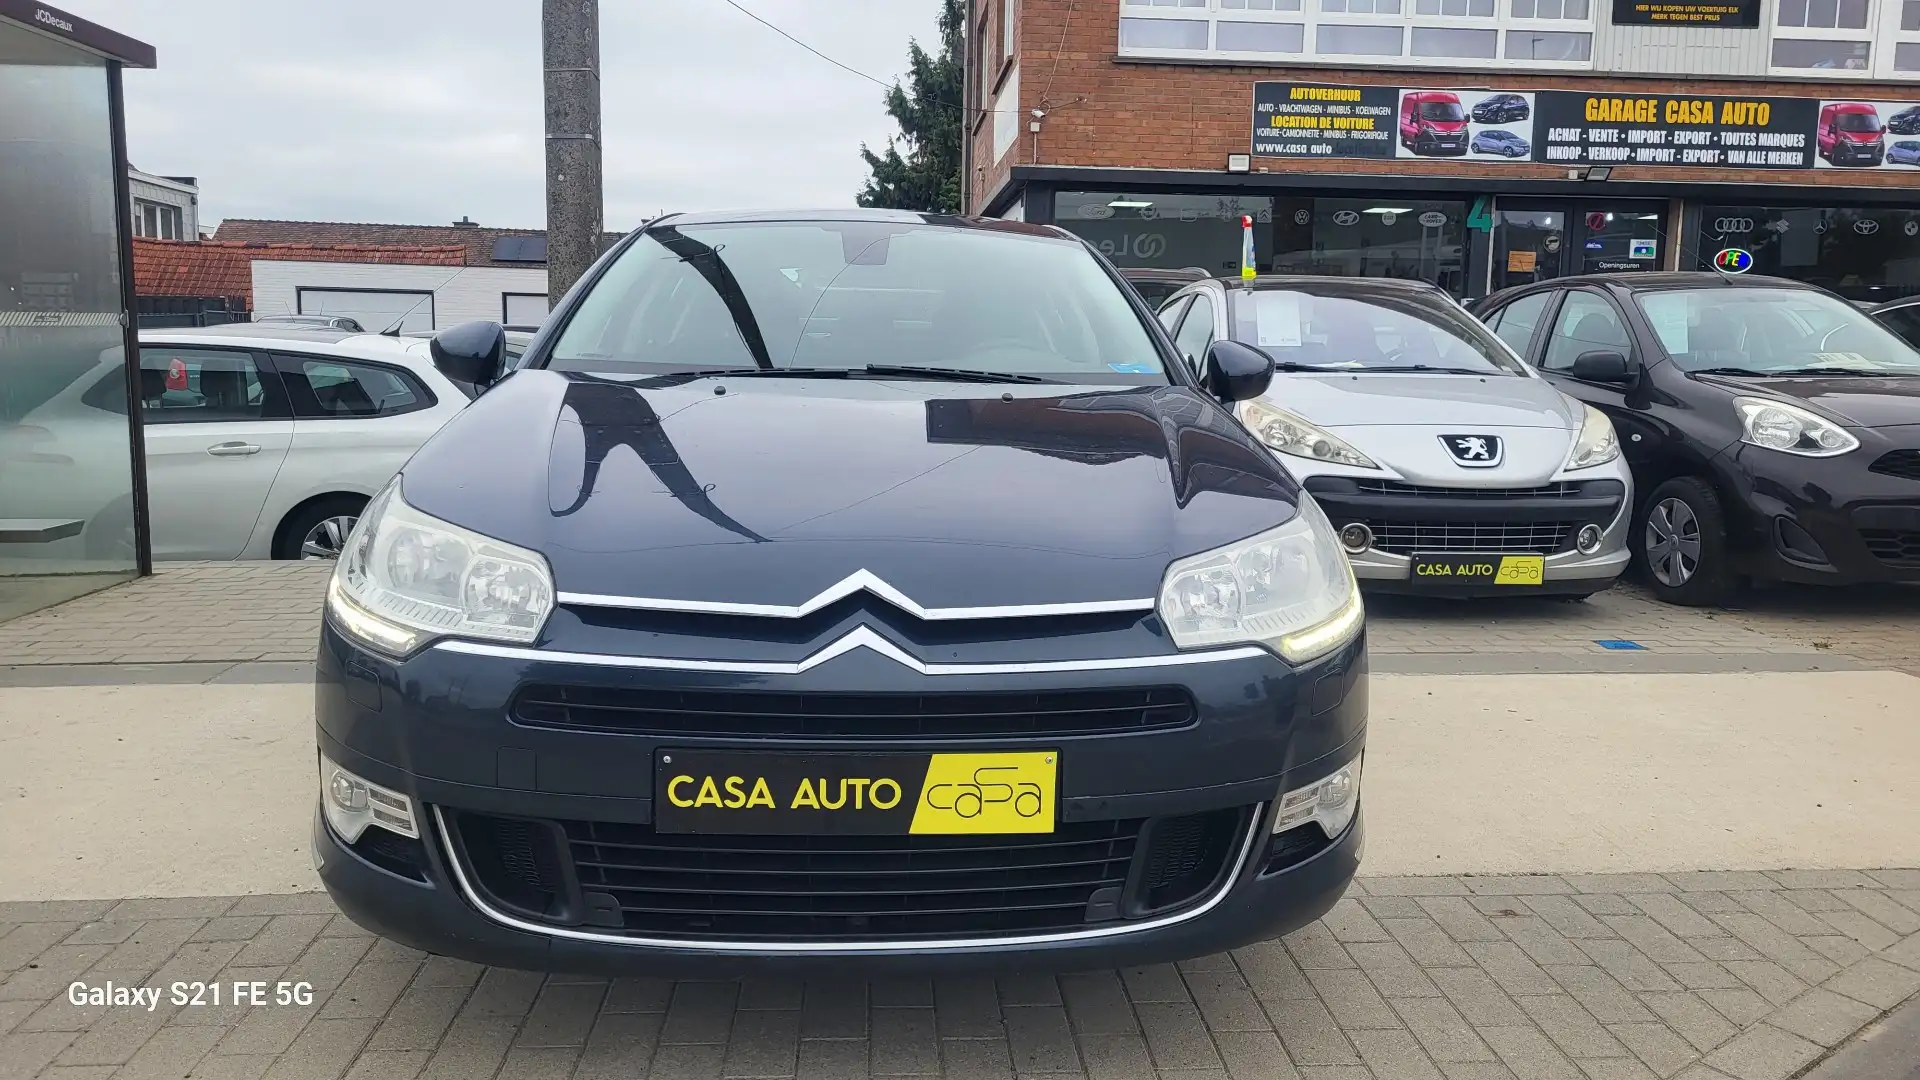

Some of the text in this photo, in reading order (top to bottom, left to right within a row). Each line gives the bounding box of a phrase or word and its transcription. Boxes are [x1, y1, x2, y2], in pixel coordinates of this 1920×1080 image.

[35, 8, 73, 32] JCDecaux
[1290, 87, 1361, 101] AUTOVERHUUR
[1257, 103, 1391, 116] AUTO VRACHTWAGEN MINIBUS KOELWAGEN
[1585, 97, 1770, 126] GARAGE CASA AUTO
[1271, 115, 1374, 130] LOCATION DE VOITURE
[1323, 131, 1347, 139] MINIBUS
[1351, 131, 1389, 140] FRIGORIFIQUE
[1548, 127, 1805, 148] ACHAT VENTE IMPORT EXPORT TOUTES MARQUES
[1256, 143, 1307, 153] www.casa
[1310, 143, 1332, 154] auto
[1546, 146, 1803, 165] INKOOP VERKOOP IMPORT EXPORT VAN ALLE MERKEN
[1466, 195, 1493, 232] 4
[1598, 261, 1640, 270] Openingsuren
[1416, 564, 1493, 576] CASA AUTO
[667, 775, 902, 810] CASA AUTO
